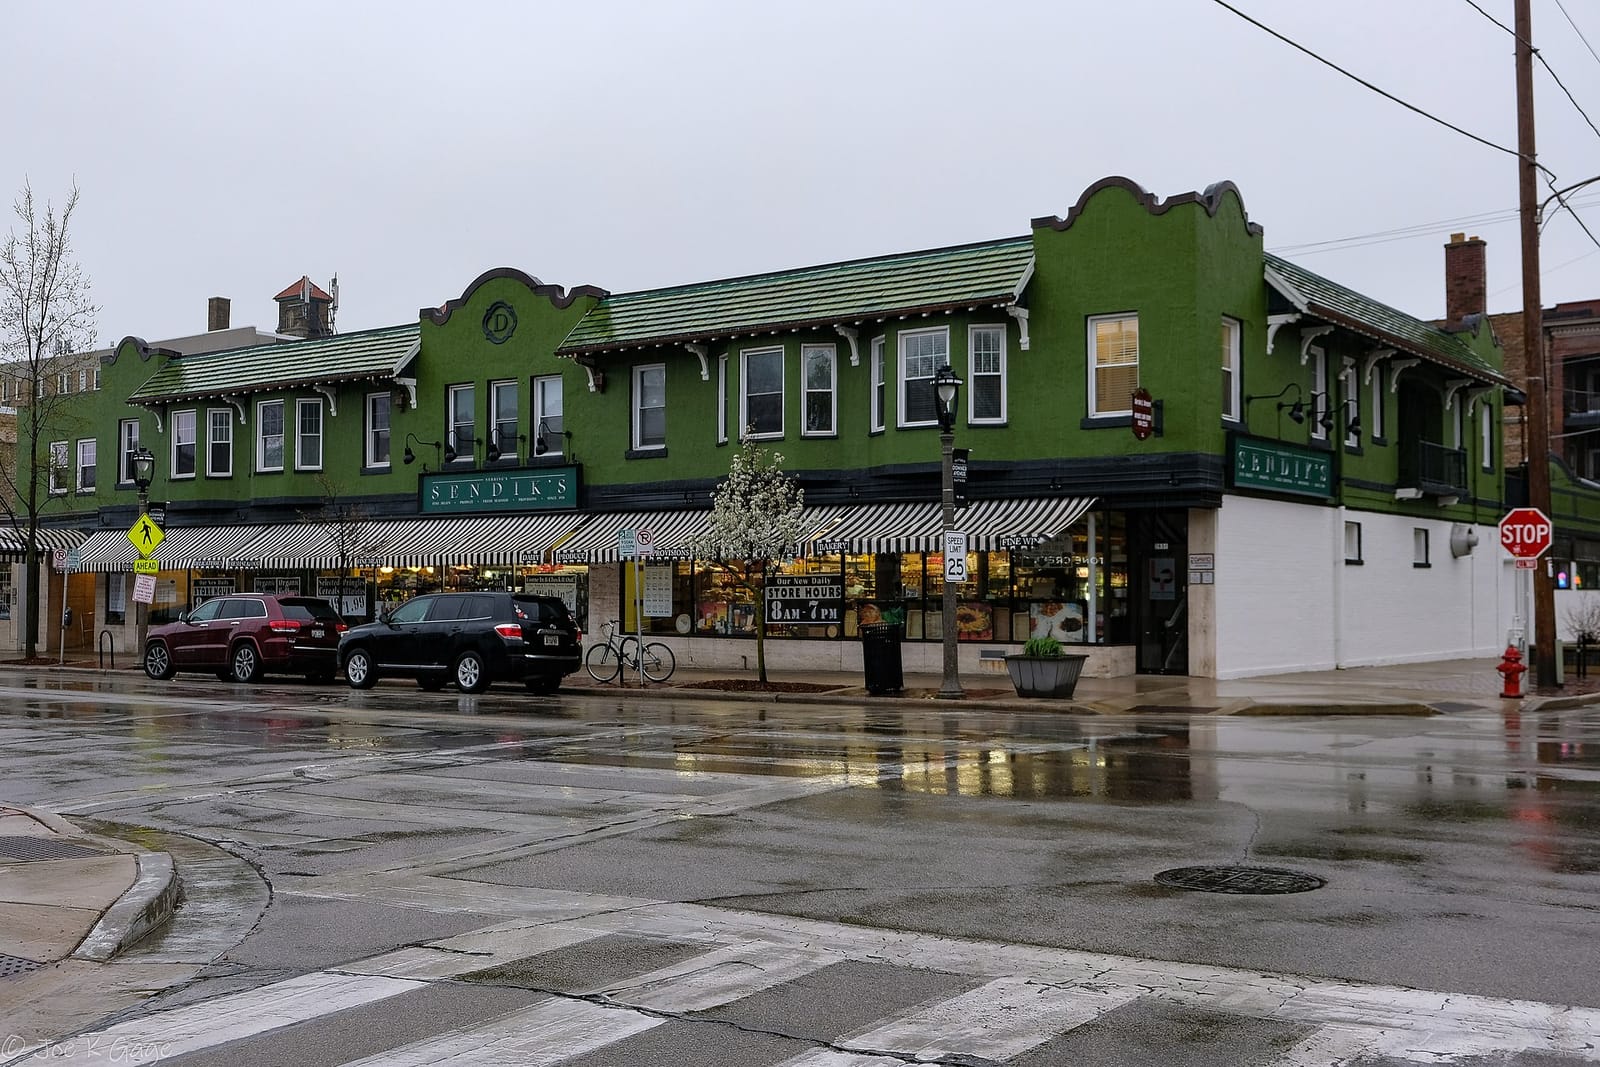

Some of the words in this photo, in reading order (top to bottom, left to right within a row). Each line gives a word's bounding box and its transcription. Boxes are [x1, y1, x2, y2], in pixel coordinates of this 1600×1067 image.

[431, 479, 566, 500] SENDIK'S
[1502, 524, 1549, 544] STOP
[947, 536, 963, 545] SPEED
[1002, 537, 1020, 546] FINE
[819, 542, 848, 551] BAKERY
[949, 545, 962, 553] LIMIT
[135, 562, 157, 570] AHEAD
[947, 558, 964, 576] 25
[776, 577, 790, 585] Our
[793, 577, 808, 585] New
[811, 577, 831, 585] Daily
[768, 587, 801, 598] STORE
[805, 587, 841, 598] HOURS
